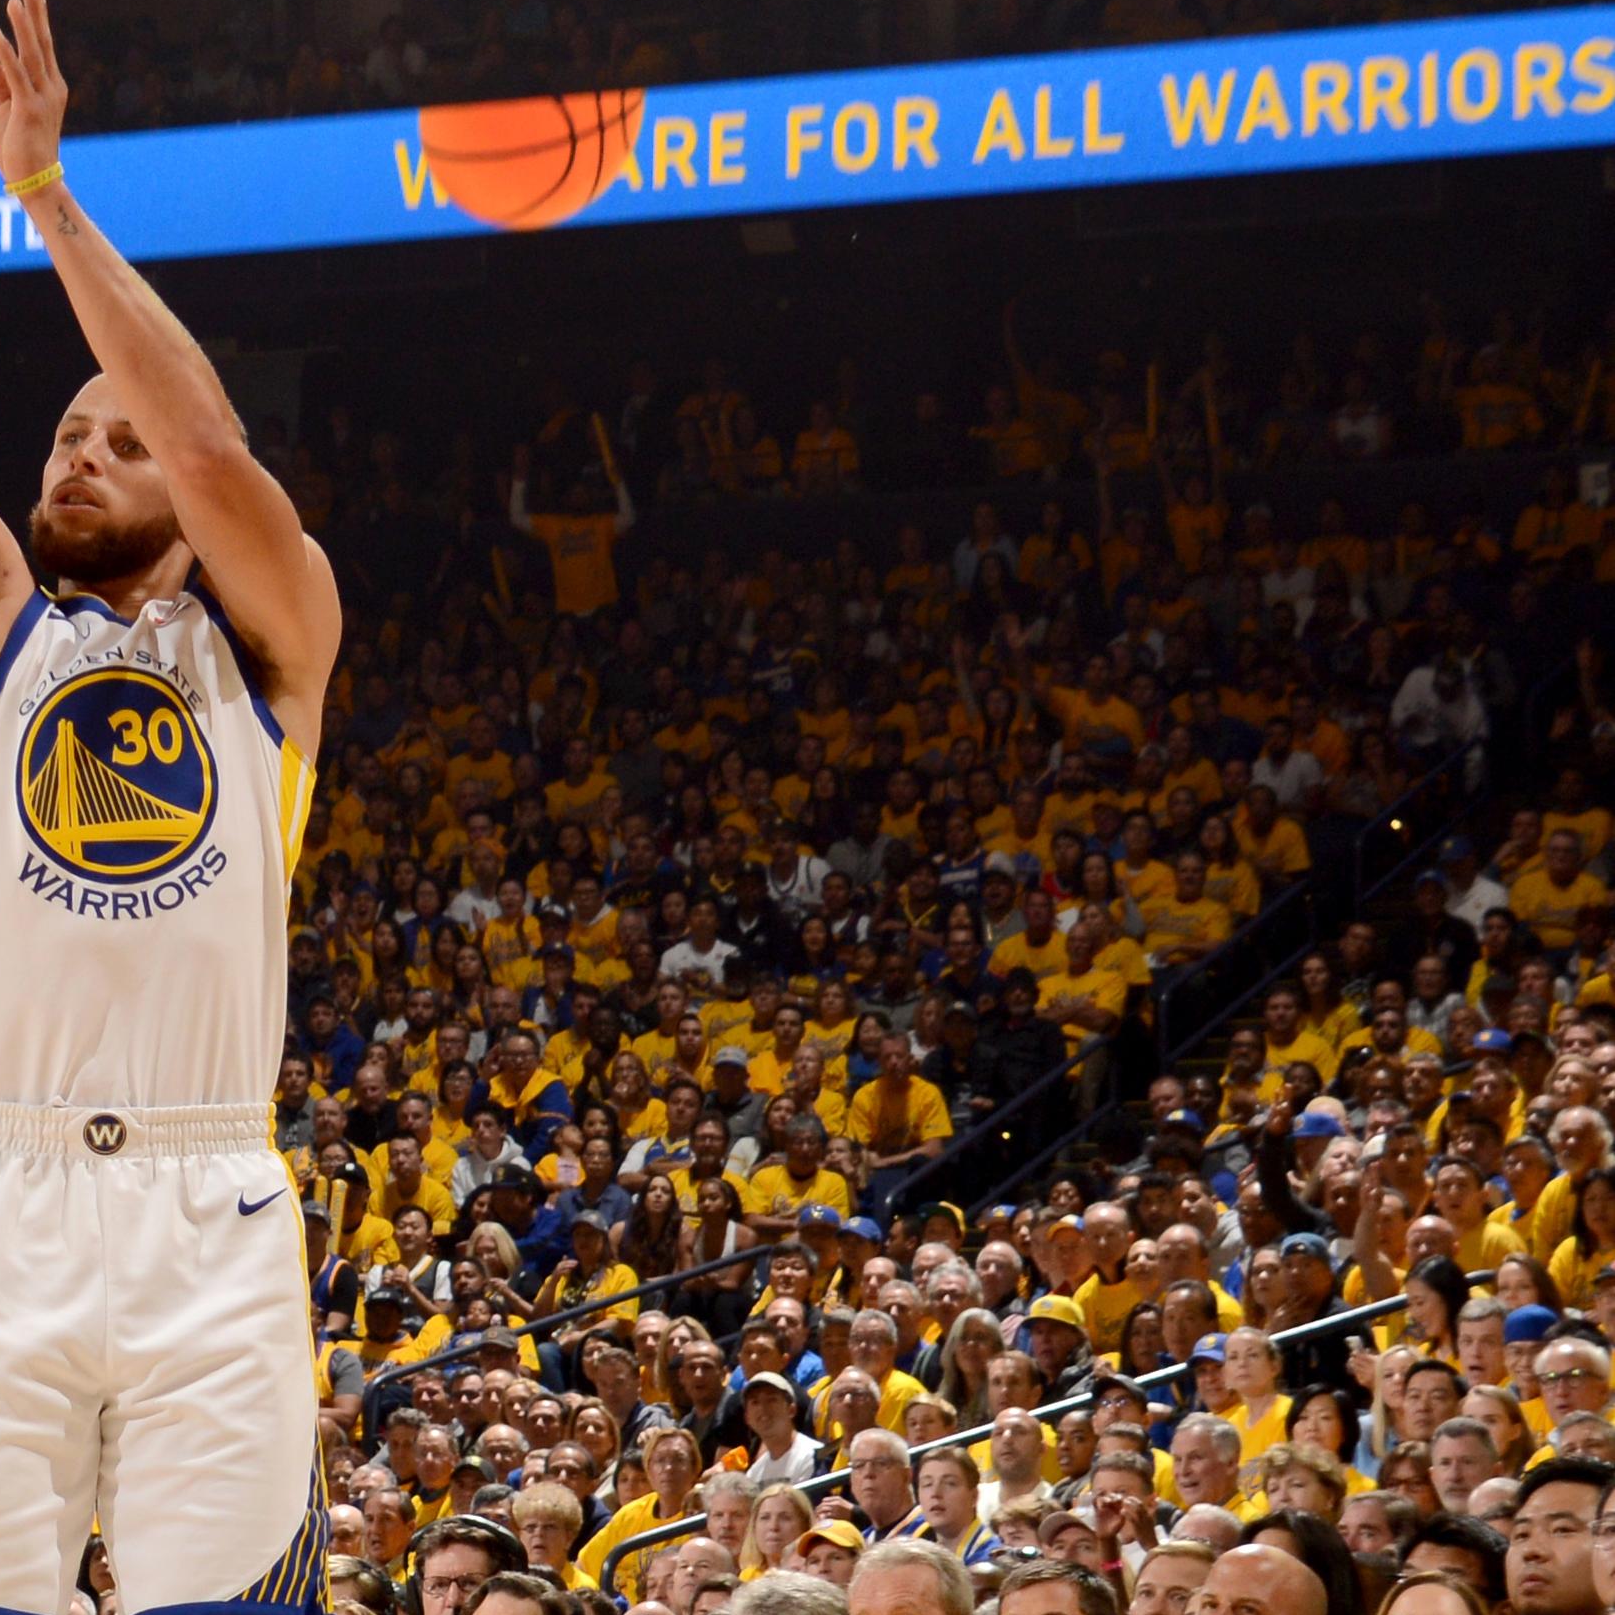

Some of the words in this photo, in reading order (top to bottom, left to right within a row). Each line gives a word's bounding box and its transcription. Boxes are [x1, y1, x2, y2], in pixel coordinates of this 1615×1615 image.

[784, 96, 940, 180] FOR
[971, 79, 1125, 164] ALL
[1159, 37, 1615, 149] WARRIORS
[18, 646, 125, 717] GOLDEN
[135, 649, 203, 713] STATE
[107, 706, 184, 766] 30
[17, 843, 228, 921] WARRIORS
